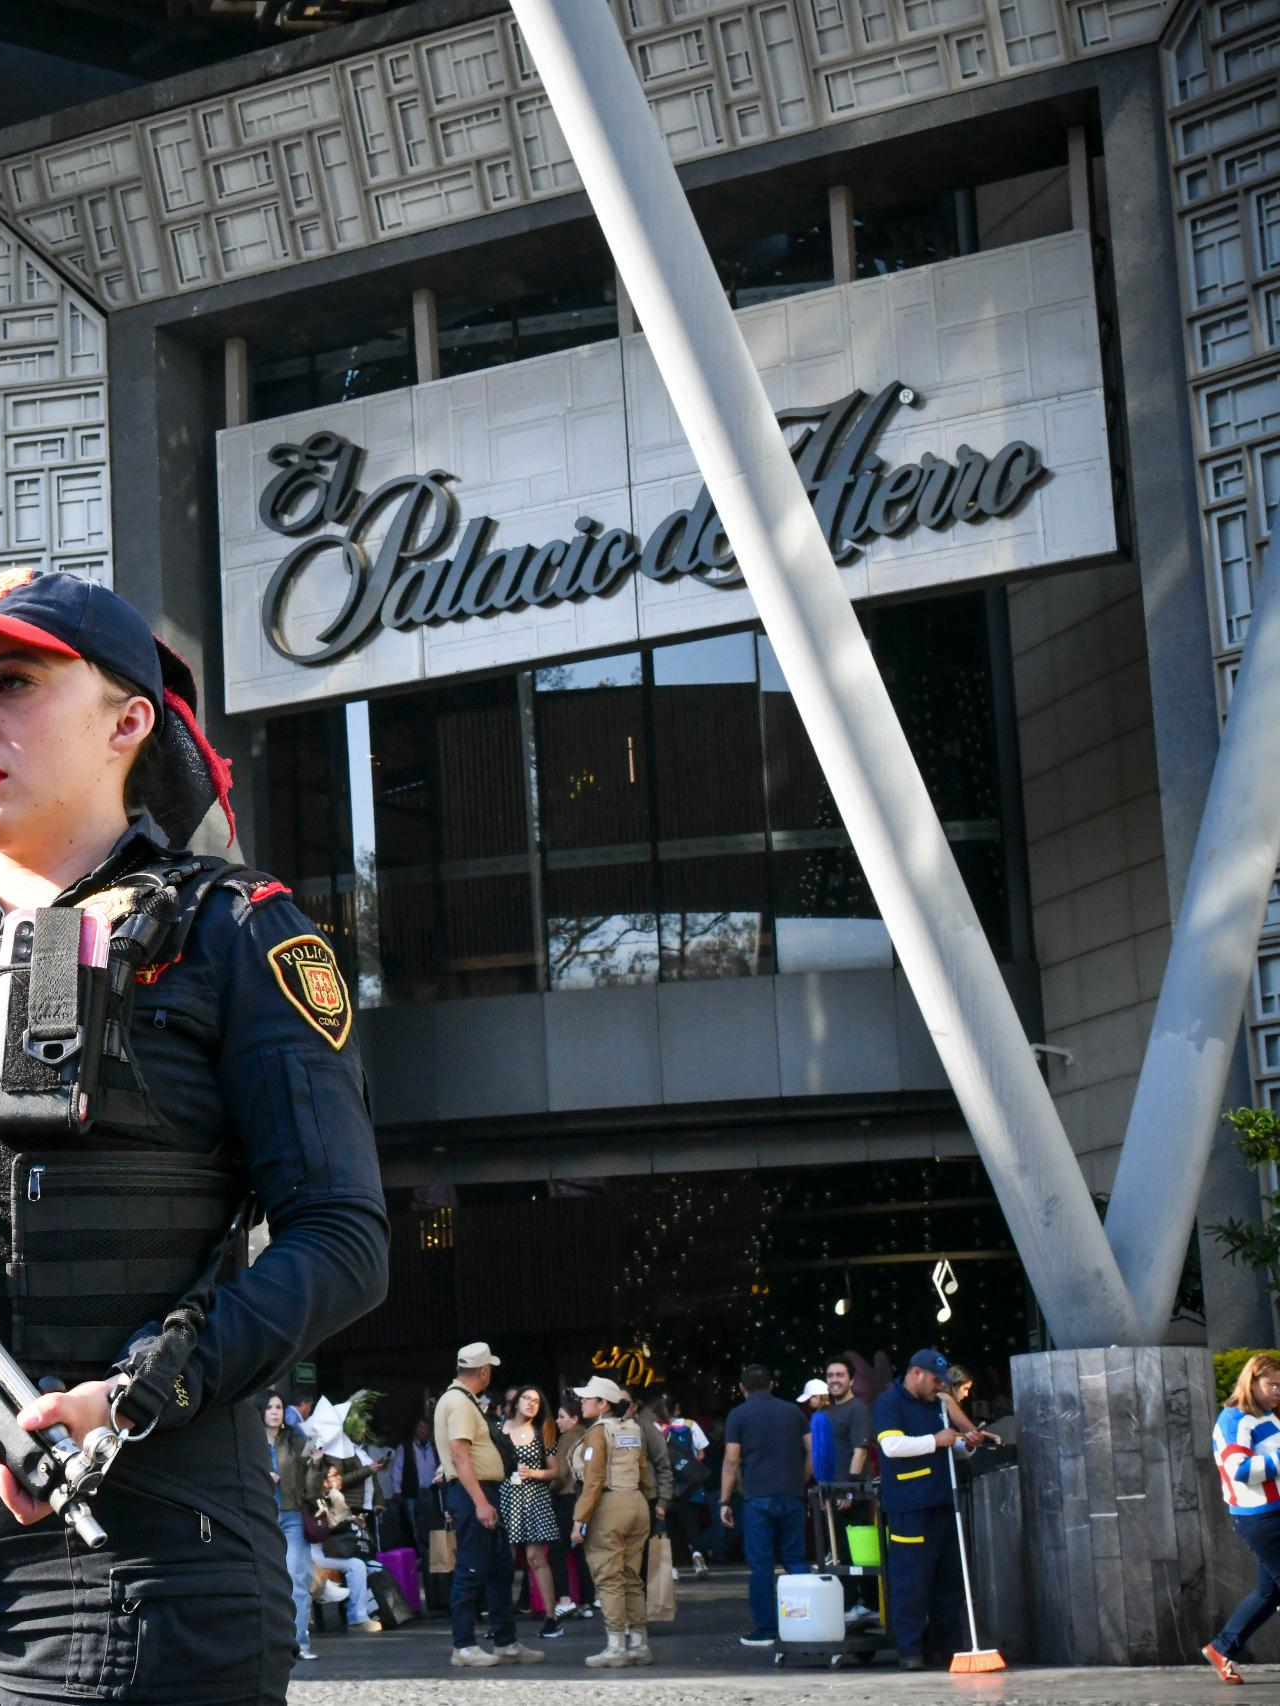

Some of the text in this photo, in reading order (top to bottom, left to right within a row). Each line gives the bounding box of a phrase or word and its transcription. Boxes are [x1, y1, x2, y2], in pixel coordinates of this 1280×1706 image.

[259, 430, 366, 536] El
[261, 468, 638, 664] Palacio
[774, 380, 1048, 563] Hierro
